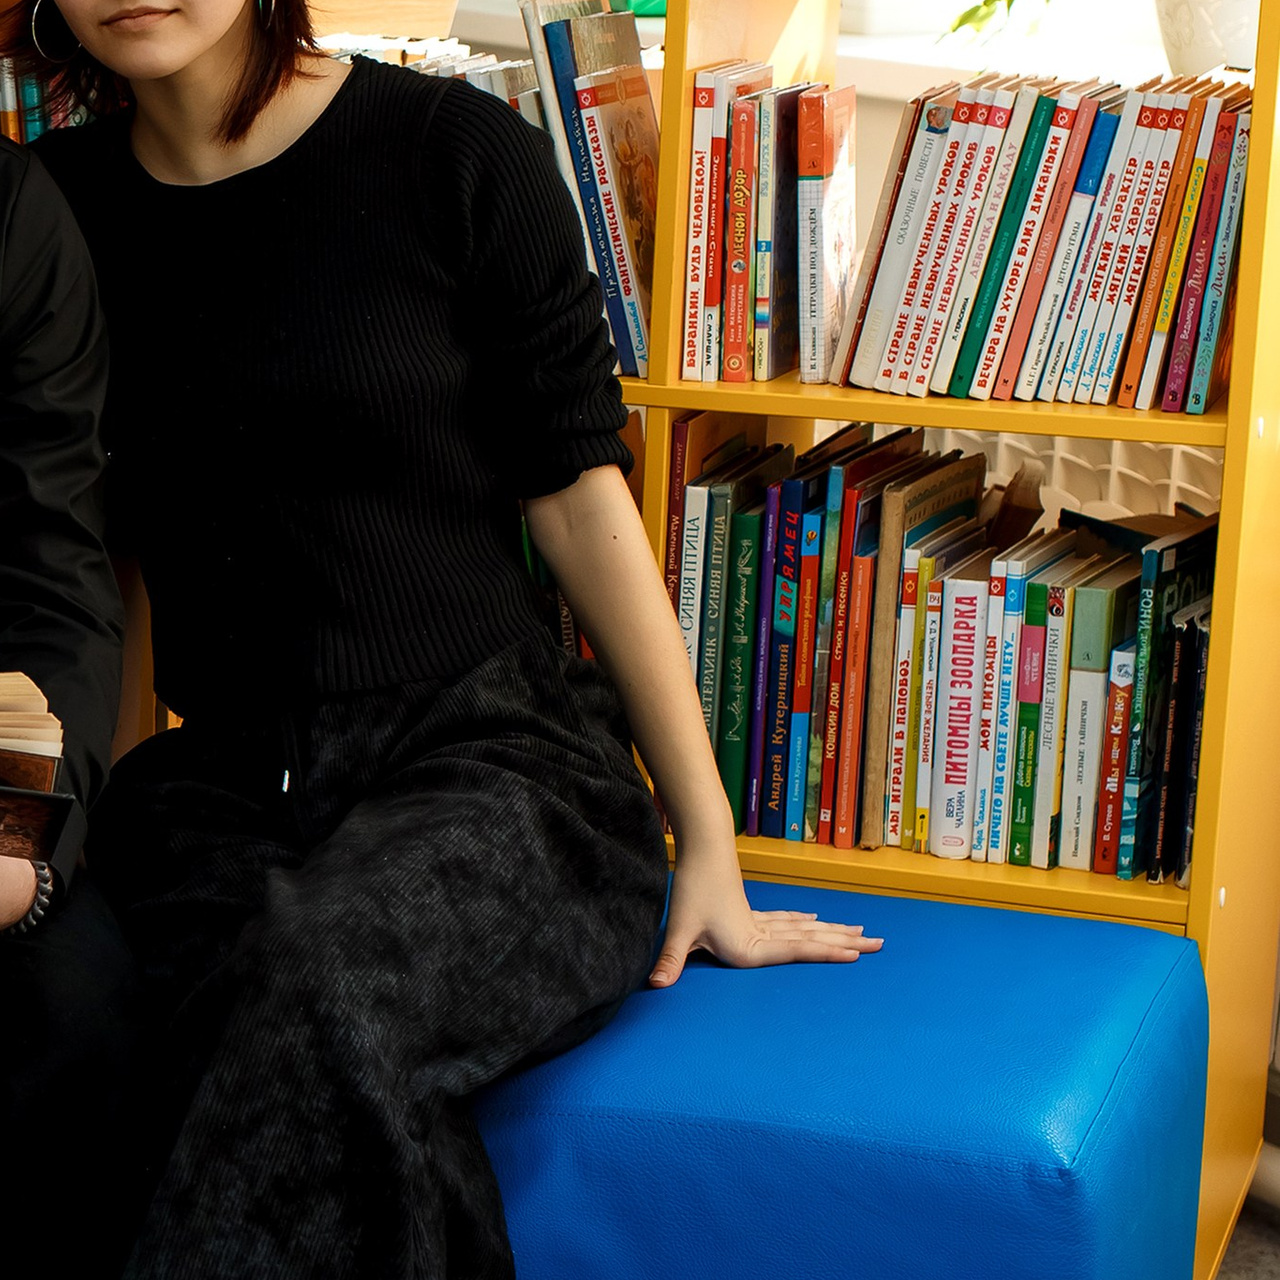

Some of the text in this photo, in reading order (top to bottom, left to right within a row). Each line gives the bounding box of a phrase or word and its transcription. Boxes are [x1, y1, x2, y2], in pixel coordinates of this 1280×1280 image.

[584, 115, 633, 296] ФАНТАСТИЧЕСКИЕ РАССКАЗЫ
[690, 245, 701, 282] БУДЬ
[691, 150, 706, 239] ЧЕЛОВЕКОМ!
[882, 140, 960, 378] В СТРАНЕ НЕВЫУЧЕННЫХ УРОКОВ
[779, 511, 799, 622] УПРЯМЕЦ
[768, 643, 790, 810] Андрей Кутерницкий
[825, 682, 840, 759] КОШКИН ДОМ
[944, 596, 978, 785] ПИТОМЦЫ ЗООПАРКА
